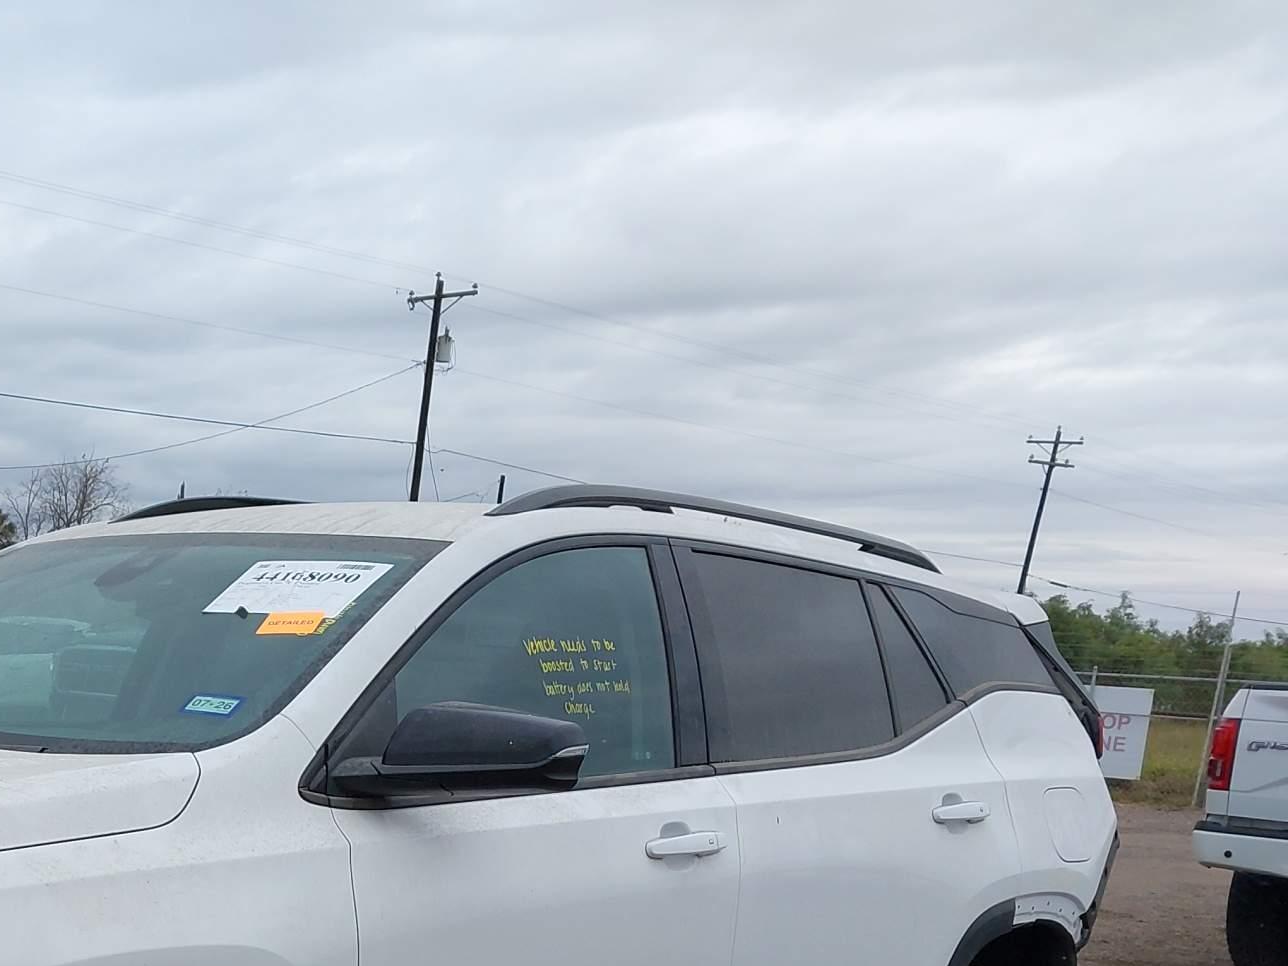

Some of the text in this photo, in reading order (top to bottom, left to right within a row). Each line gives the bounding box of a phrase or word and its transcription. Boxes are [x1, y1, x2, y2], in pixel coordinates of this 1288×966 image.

[252, 571, 361, 584] 44168090
[523, 636, 557, 656] Vehicle
[592, 639, 601, 652] to
[603, 638, 616, 651] be
[540, 659, 575, 672] boosted
[580, 658, 589, 671] to
[543, 680, 575, 700] battery
[596, 680, 611, 692] not
[192, 699, 234, 710] 07-26
